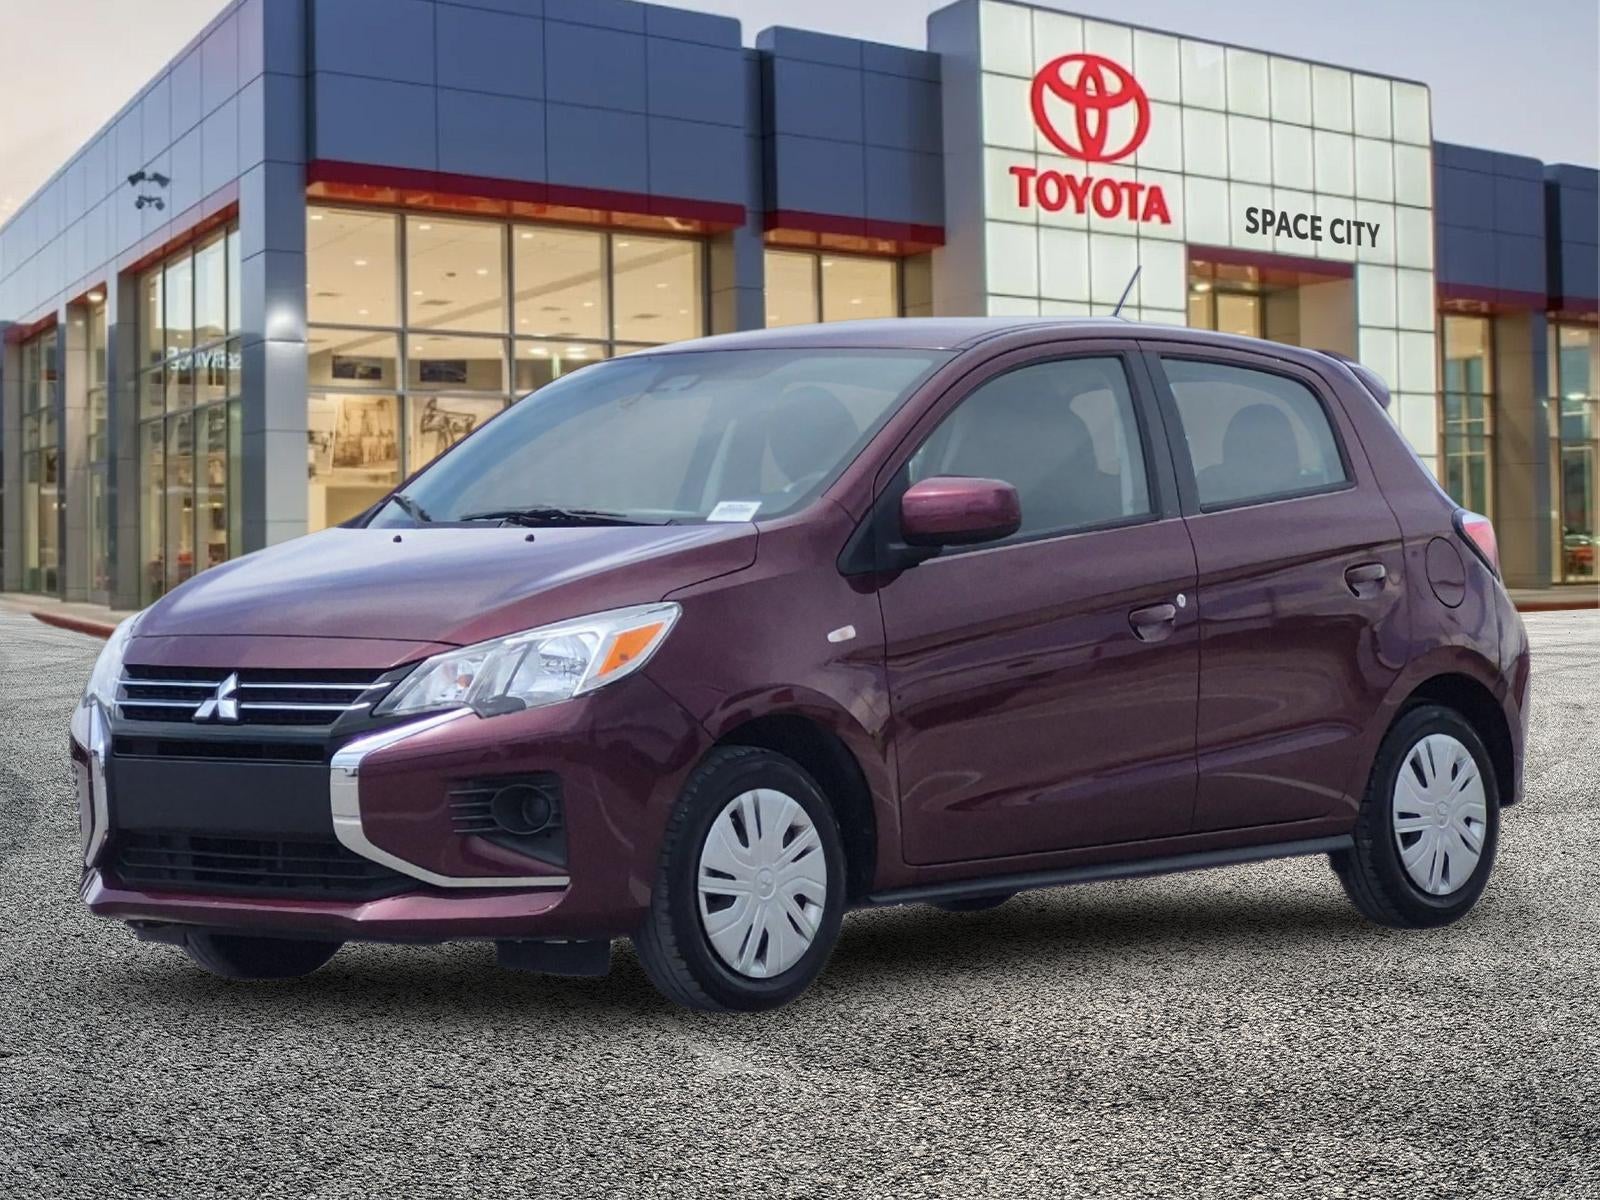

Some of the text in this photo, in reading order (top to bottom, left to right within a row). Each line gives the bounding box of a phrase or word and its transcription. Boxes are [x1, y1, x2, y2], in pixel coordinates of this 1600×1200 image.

[1010, 166, 1171, 224] TOYOTA
[1245, 206, 1381, 248] SPACE CITY
